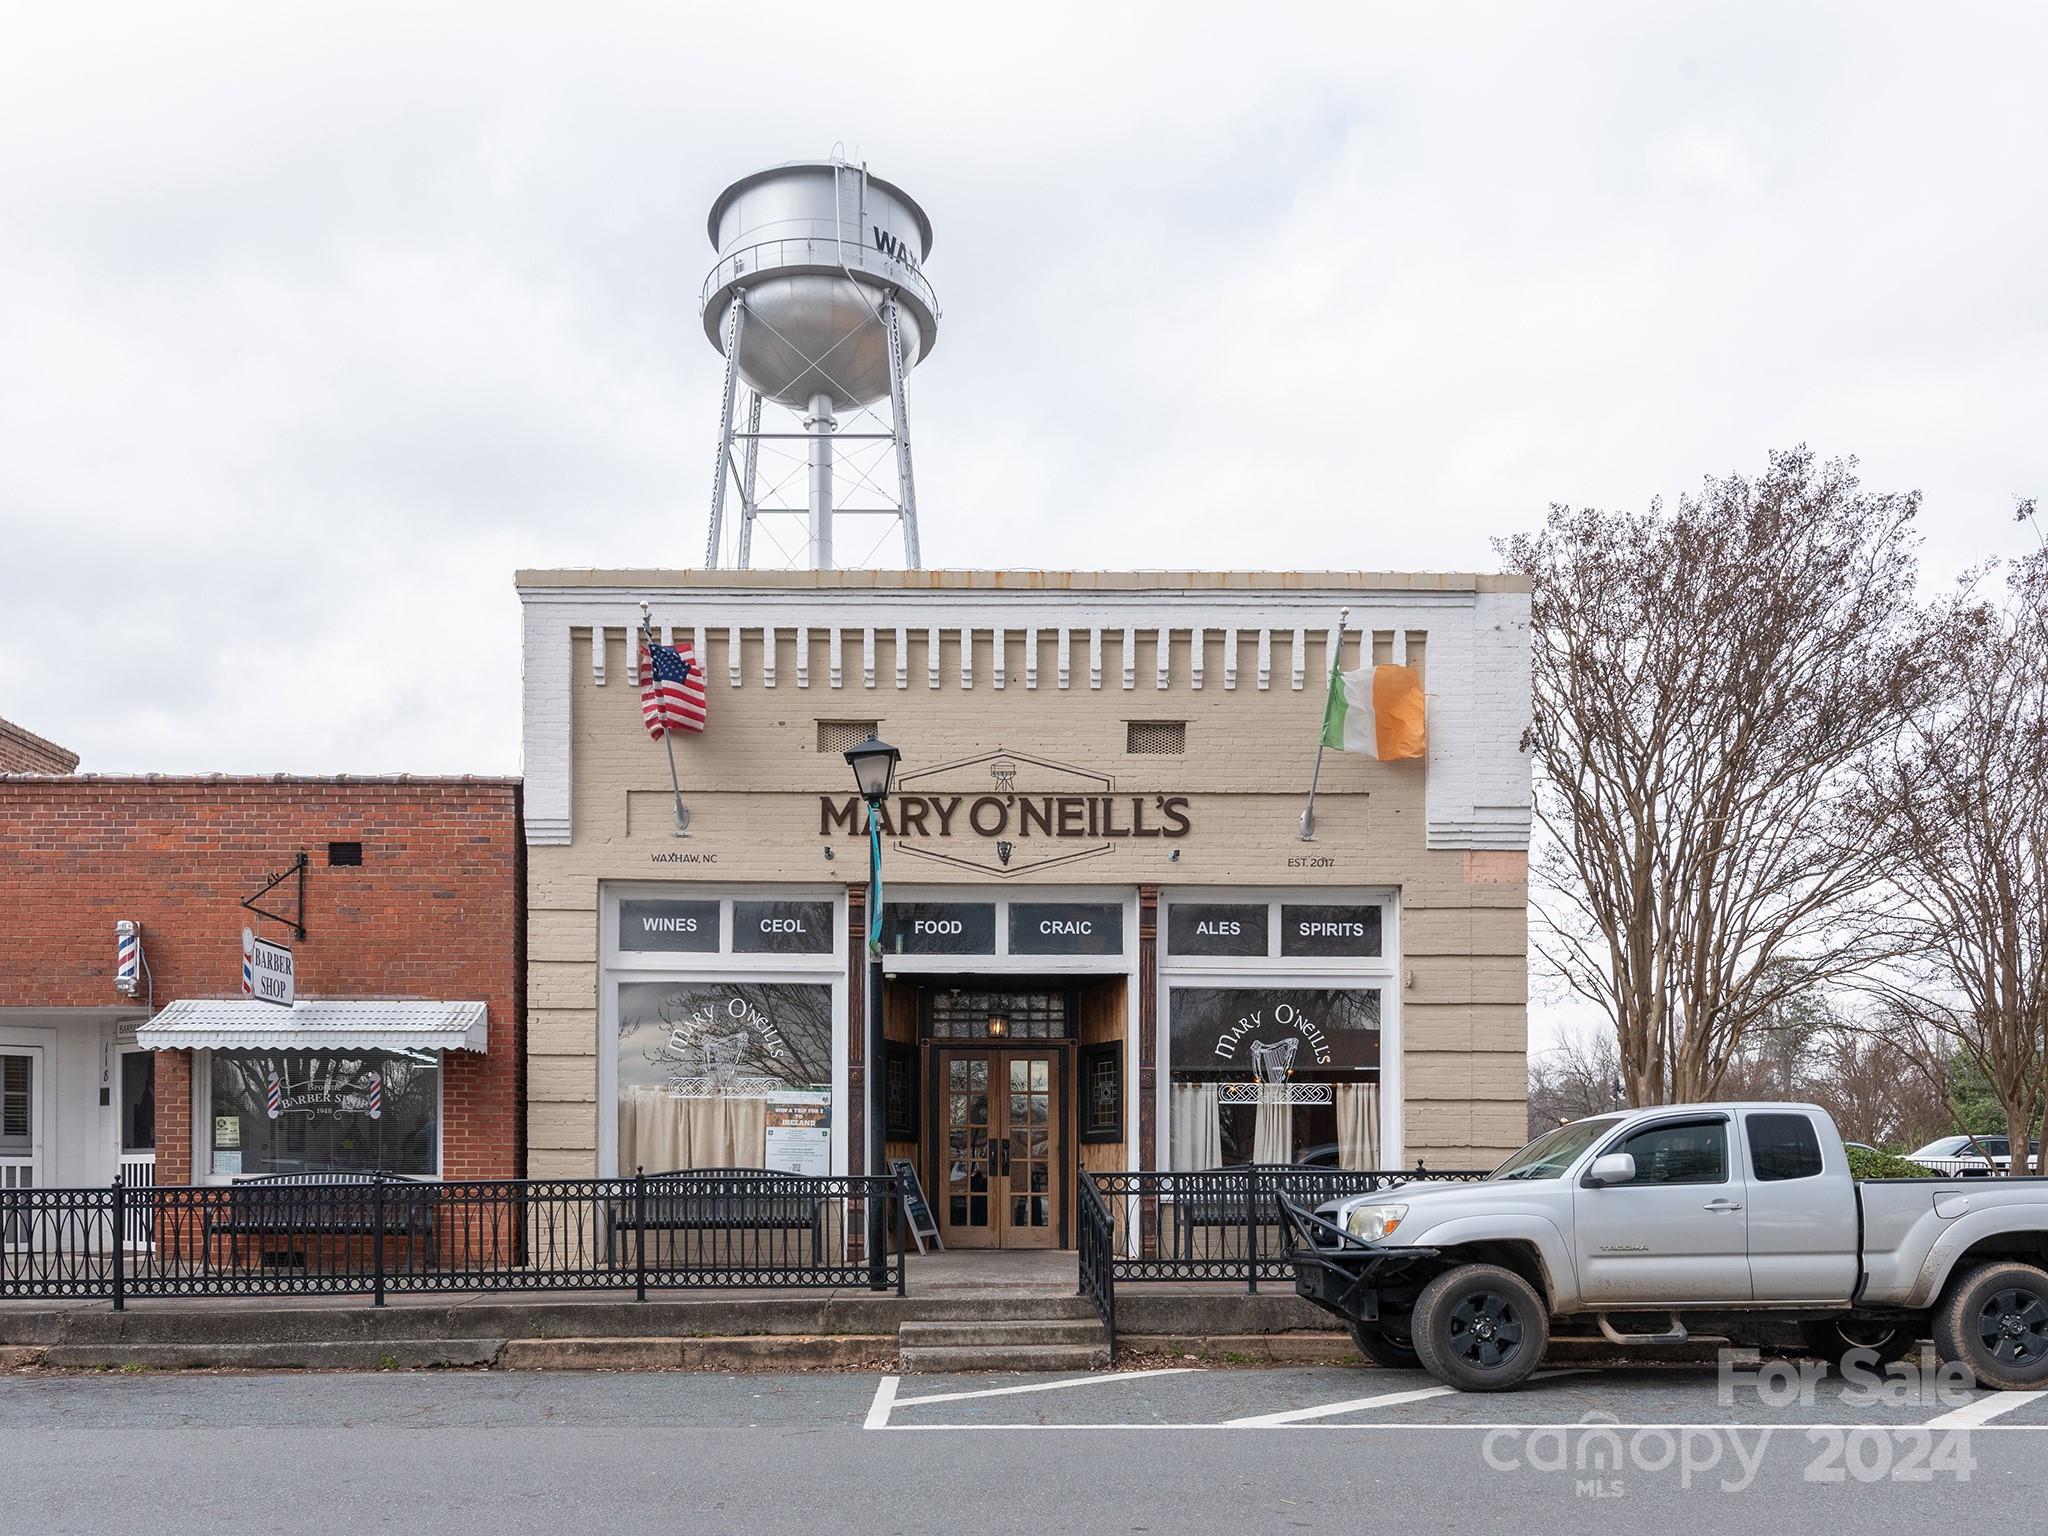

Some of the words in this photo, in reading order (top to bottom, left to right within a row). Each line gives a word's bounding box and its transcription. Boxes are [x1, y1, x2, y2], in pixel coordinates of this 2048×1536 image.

[819, 796, 962, 836] MARY
[970, 796, 1191, 837] O'NEILL'S
[651, 853, 701, 864] WAXHAW,
[702, 854, 718, 863] NC
[1288, 858, 1309, 868] EST.
[1310, 857, 1335, 868] 2017
[643, 917, 697, 932] WINES
[760, 919, 806, 933] CEOL
[914, 920, 962, 934] FOOD
[1039, 920, 1092, 935] CRAIC
[1196, 921, 1241, 935] ALES
[1299, 922, 1364, 936] SPIRITS
[255, 948, 292, 975] BARBER
[261, 976, 286, 998] SHOP
[282, 1093, 332, 1109] BARBER
